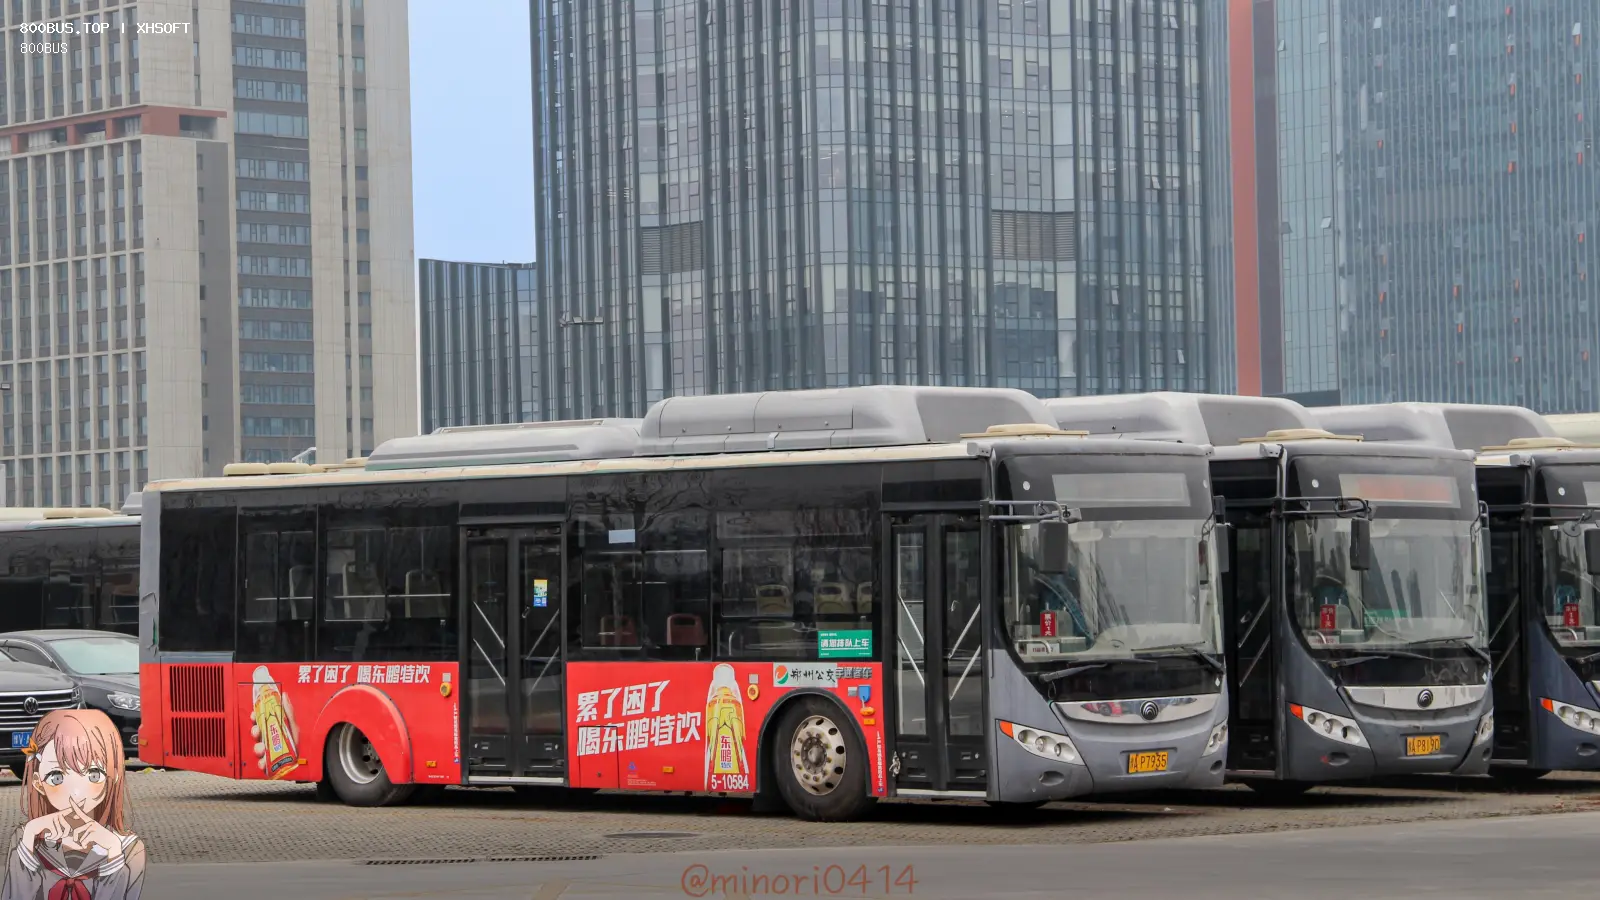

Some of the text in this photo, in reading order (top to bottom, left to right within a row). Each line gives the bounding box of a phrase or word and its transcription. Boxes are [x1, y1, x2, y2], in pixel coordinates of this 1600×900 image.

[297, 664, 431, 684] 累了困了 喝东鹏特饮
[790, 668, 836, 683] 郑州公交
[576, 679, 671, 723] 累了困了
[576, 711, 702, 757] 喝东鹏特饮
[721, 735, 732, 762] 东鹏
[711, 774, 750, 790] 5-10584
